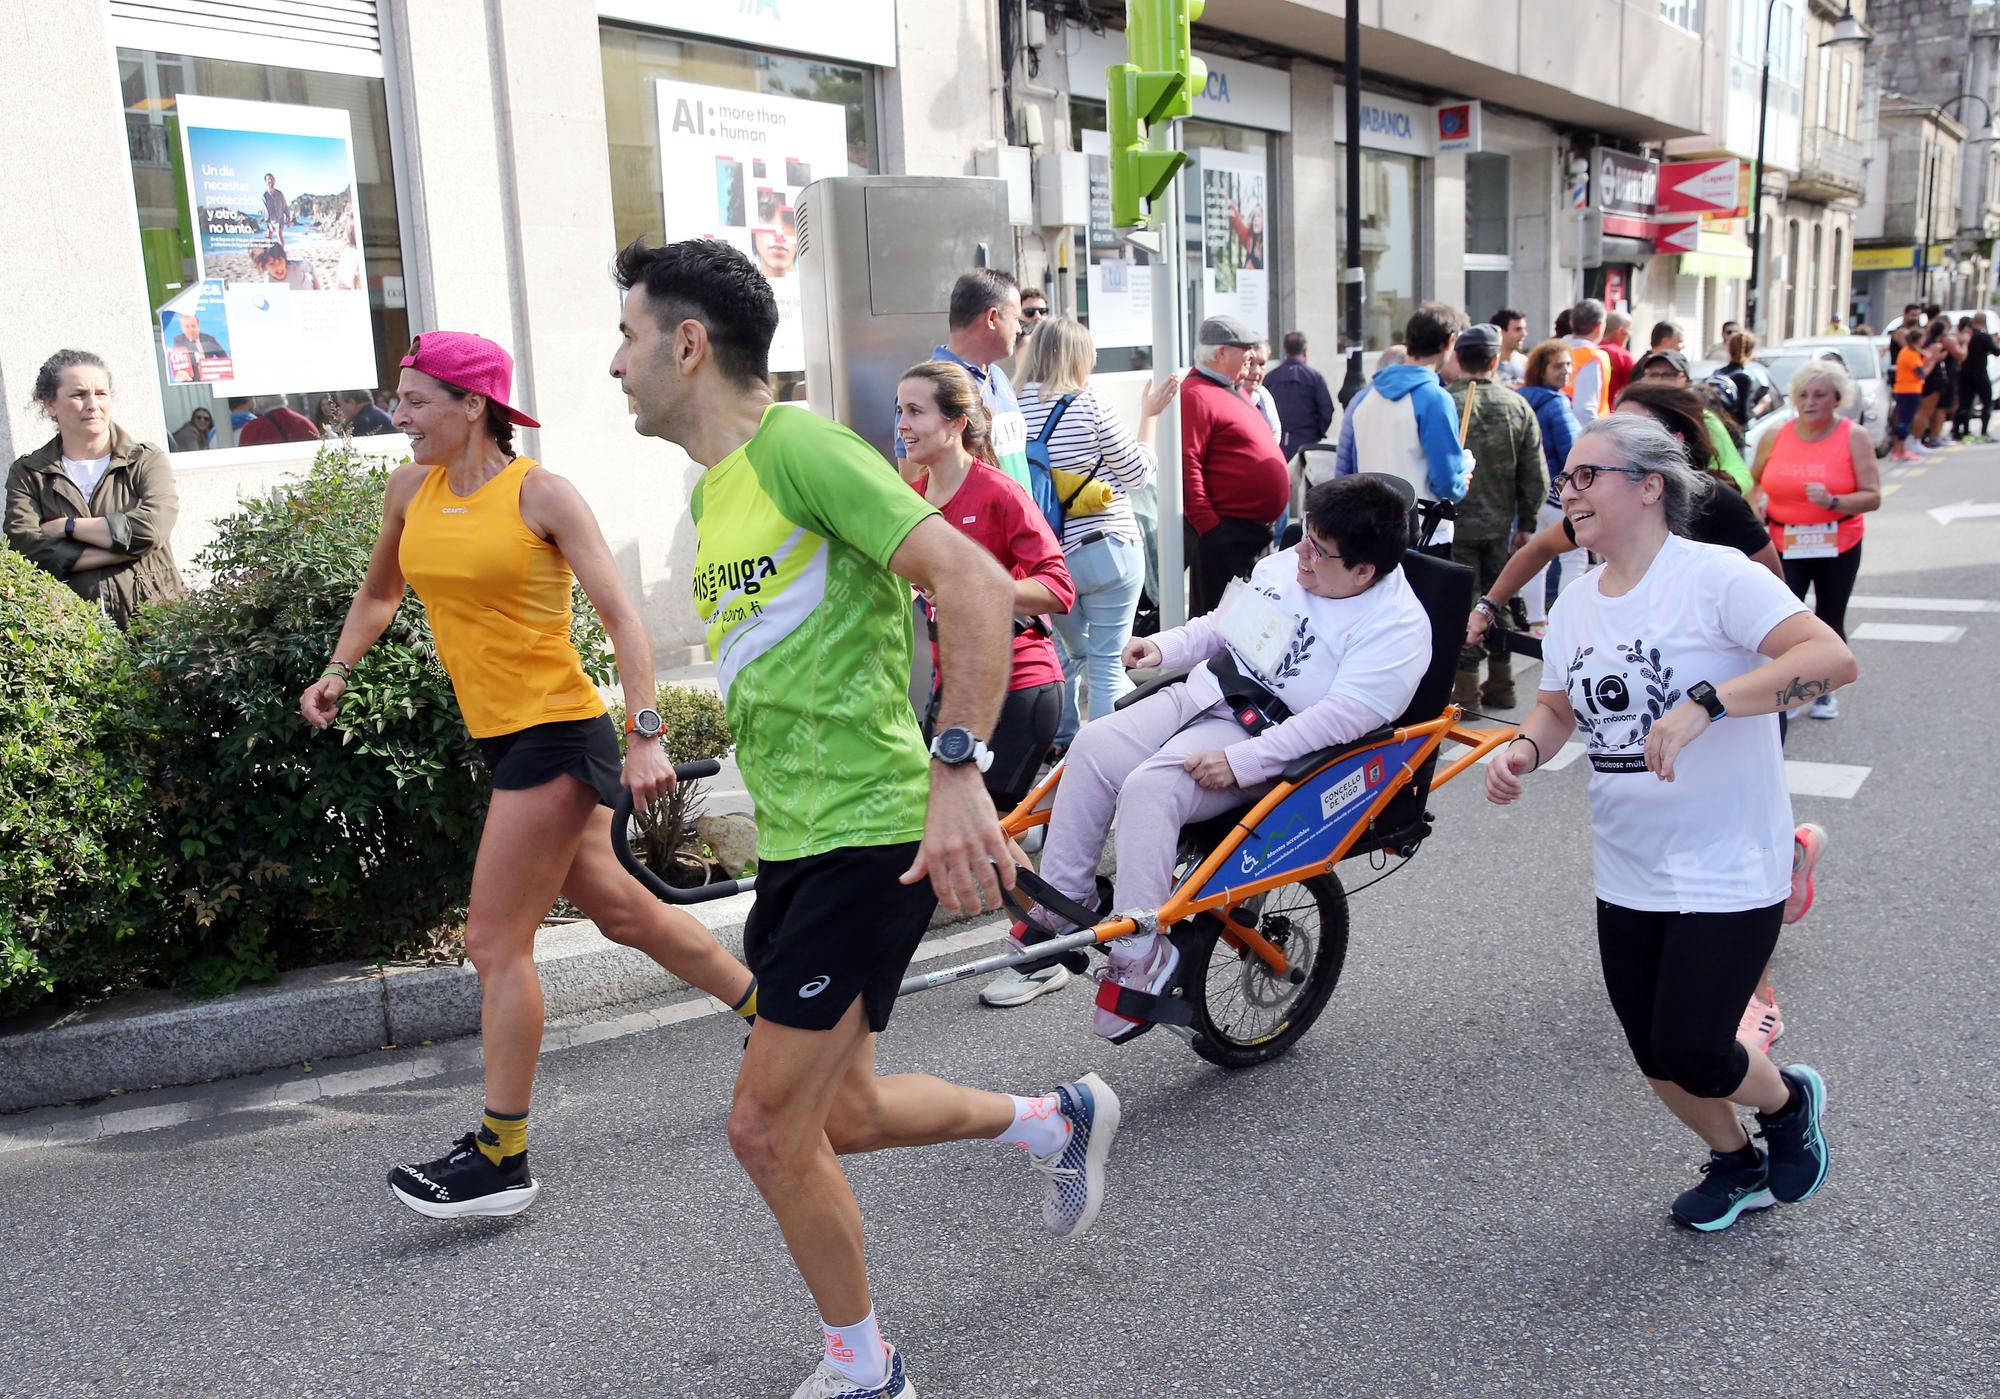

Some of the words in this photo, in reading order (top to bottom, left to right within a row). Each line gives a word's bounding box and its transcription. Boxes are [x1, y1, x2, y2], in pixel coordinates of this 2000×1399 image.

[719, 106, 754, 121] more
[757, 107, 786, 125] than
[720, 121, 767, 142] human
[202, 164, 218, 176] Un
[207, 209, 214, 221] y
[215, 208, 238, 220] otro
[209, 223, 223, 234] no
[718, 556, 778, 595] auga
[751, 600, 764, 618] ti
[1324, 774, 1361, 804] CONCELLO
[1329, 799, 1340, 809] DE
[1340, 785, 1358, 801] VIGO
[398, 1163, 440, 1191] CRAFT
